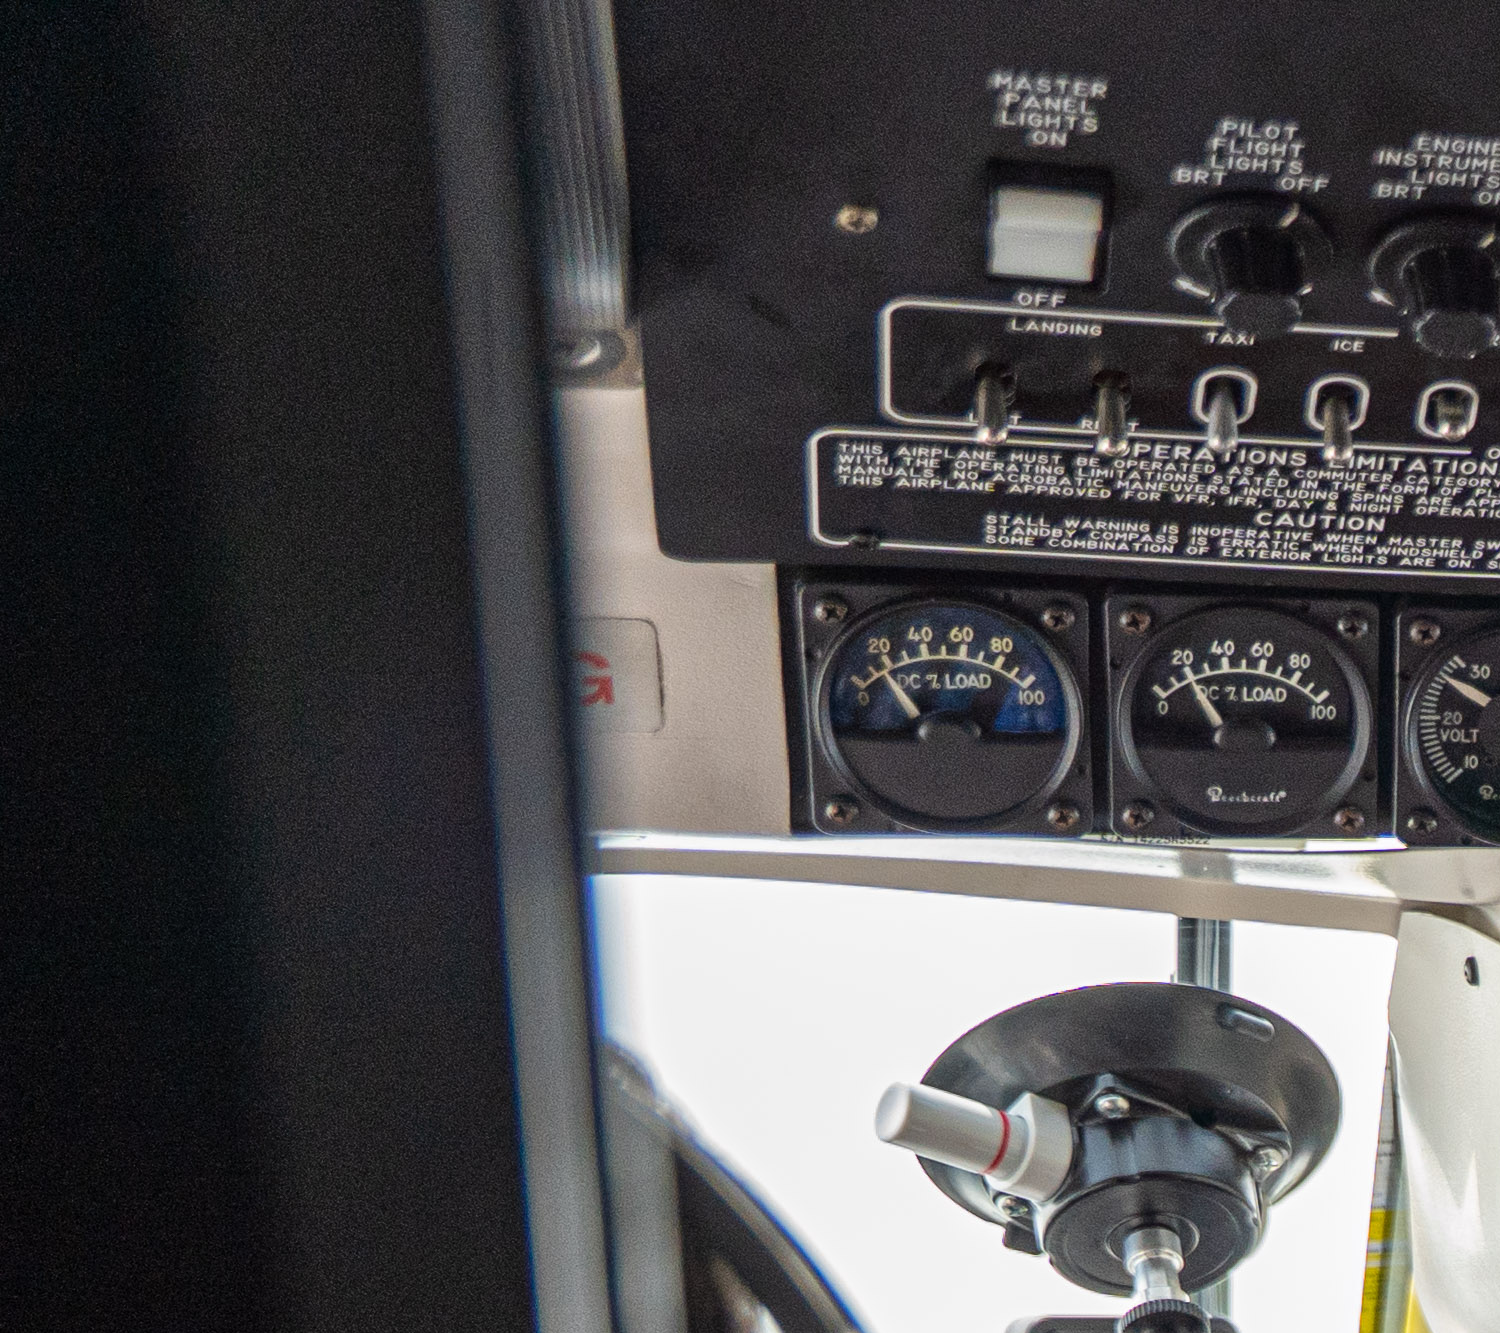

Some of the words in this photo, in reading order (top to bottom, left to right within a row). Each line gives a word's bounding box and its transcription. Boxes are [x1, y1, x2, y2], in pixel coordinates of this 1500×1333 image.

[991, 73, 1107, 99] MASTER
[1002, 92, 1095, 115] PANEL
[999, 110, 1098, 132] LIGHTS
[1221, 118, 1299, 142] PILOT
[1029, 130, 1068, 147] ON
[1208, 136, 1304, 158] FLIGHT
[1209, 154, 1303, 175] LIGHTS
[1173, 167, 1228, 185] BRT
[1280, 175, 1330, 192] OFF
[1410, 169, 1500, 190] LIGHTS
[1376, 182, 1427, 201] BRT
[1016, 292, 1067, 308] OFF
[1009, 318, 1103, 338] LANDING
[1333, 340, 1365, 353] ICE
[839, 475, 883, 486] THIS
[897, 478, 995, 492] AIRPLANE
[1010, 484, 1111, 499] APPROVED
[1124, 489, 1161, 500] FOR
[1276, 499, 1313, 510] DAY
[1350, 502, 1403, 514] NIGHT
[1254, 511, 1386, 532] CAUTION
[908, 627, 933, 642] 40
[951, 627, 973, 642] 60
[868, 638, 890, 653] 20
[990, 638, 1013, 653] 80
[945, 673, 992, 689] LOAD
[1019, 690, 1045, 705] 100
[1243, 687, 1287, 702] LOAD
[1312, 705, 1336, 719] 100
[1441, 730, 1479, 743] VOLT
